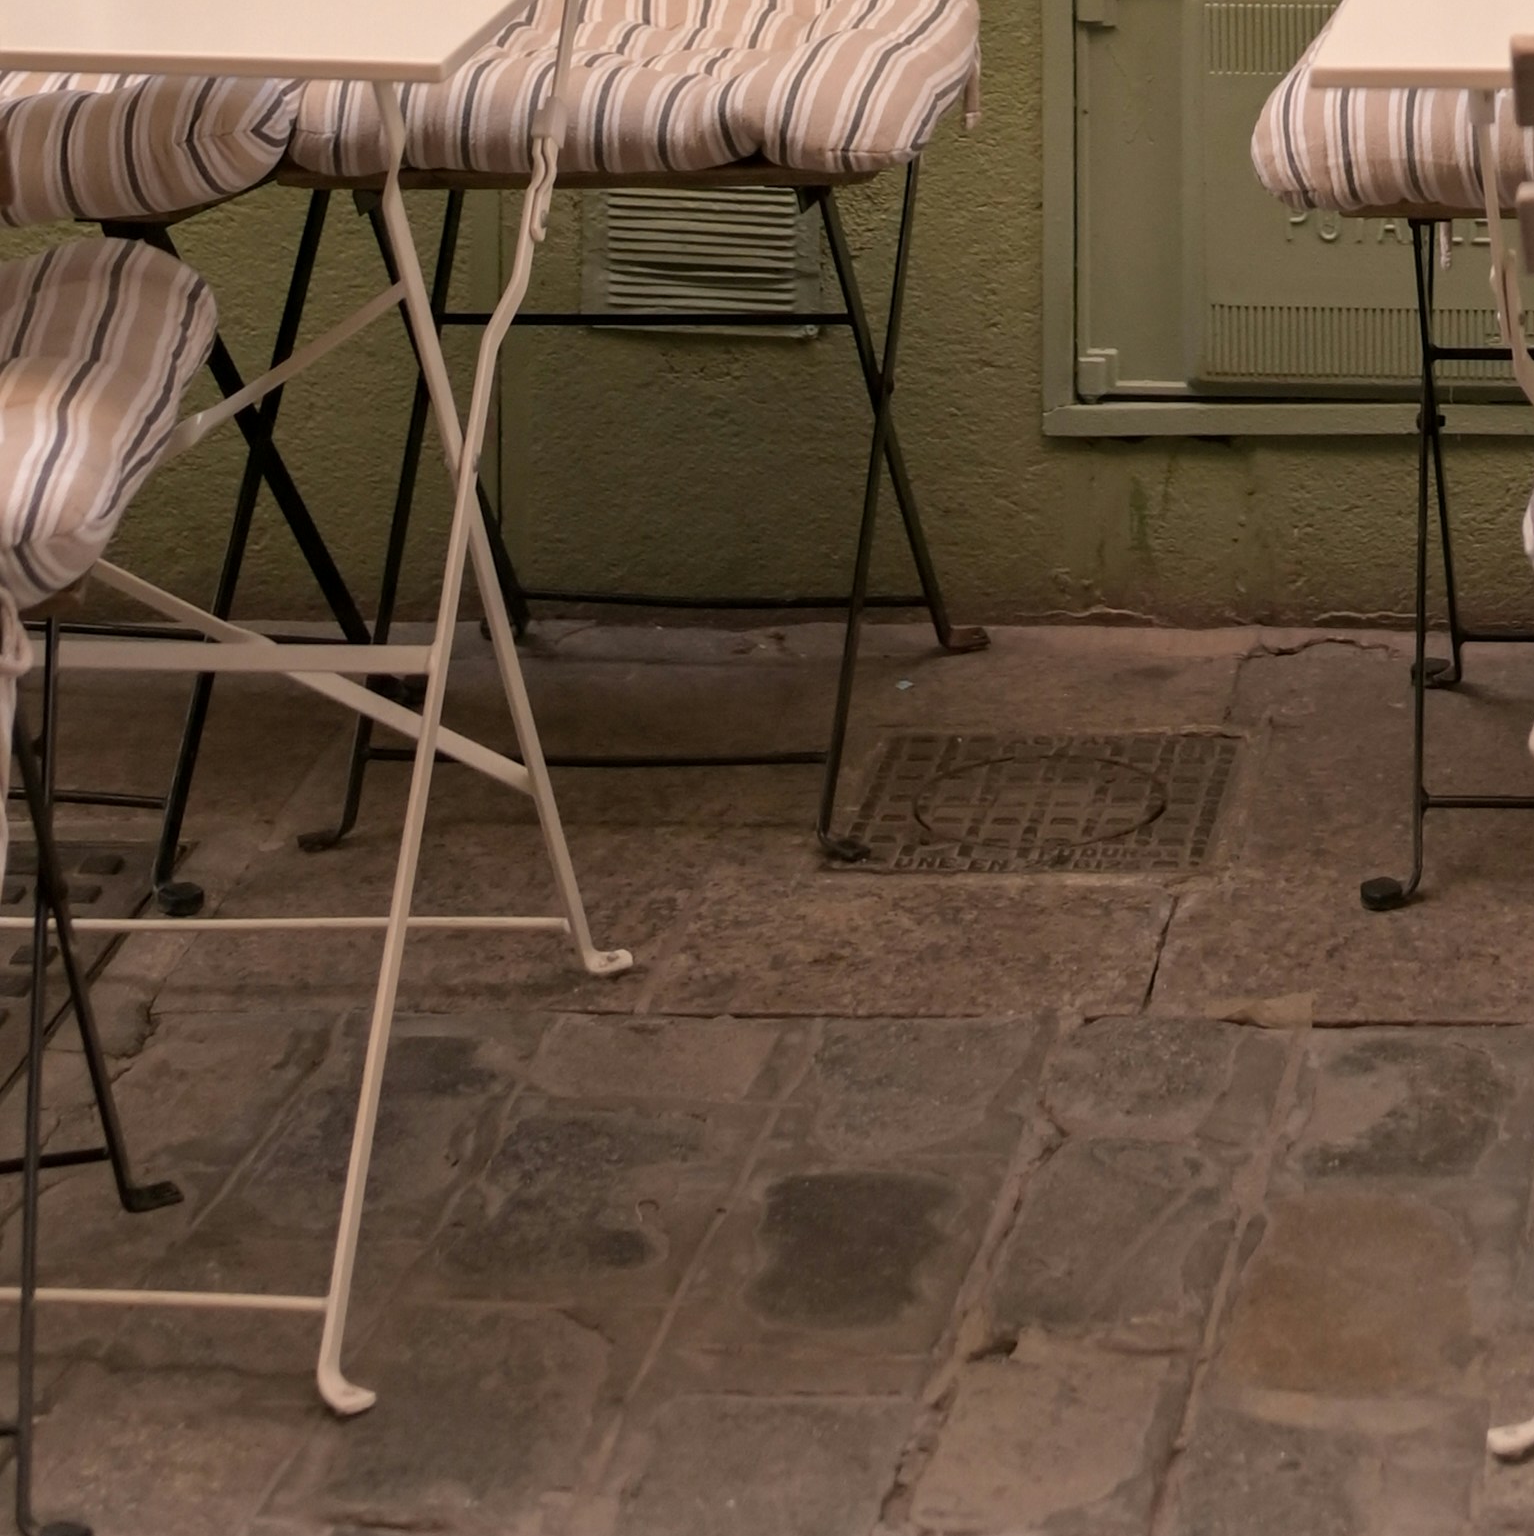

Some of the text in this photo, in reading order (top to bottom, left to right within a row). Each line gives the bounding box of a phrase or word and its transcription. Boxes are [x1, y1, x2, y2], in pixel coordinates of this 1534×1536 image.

[1286, 208, 1491, 244] POAE
[893, 856, 957, 870] UNE
[966, 856, 1010, 871] EN
